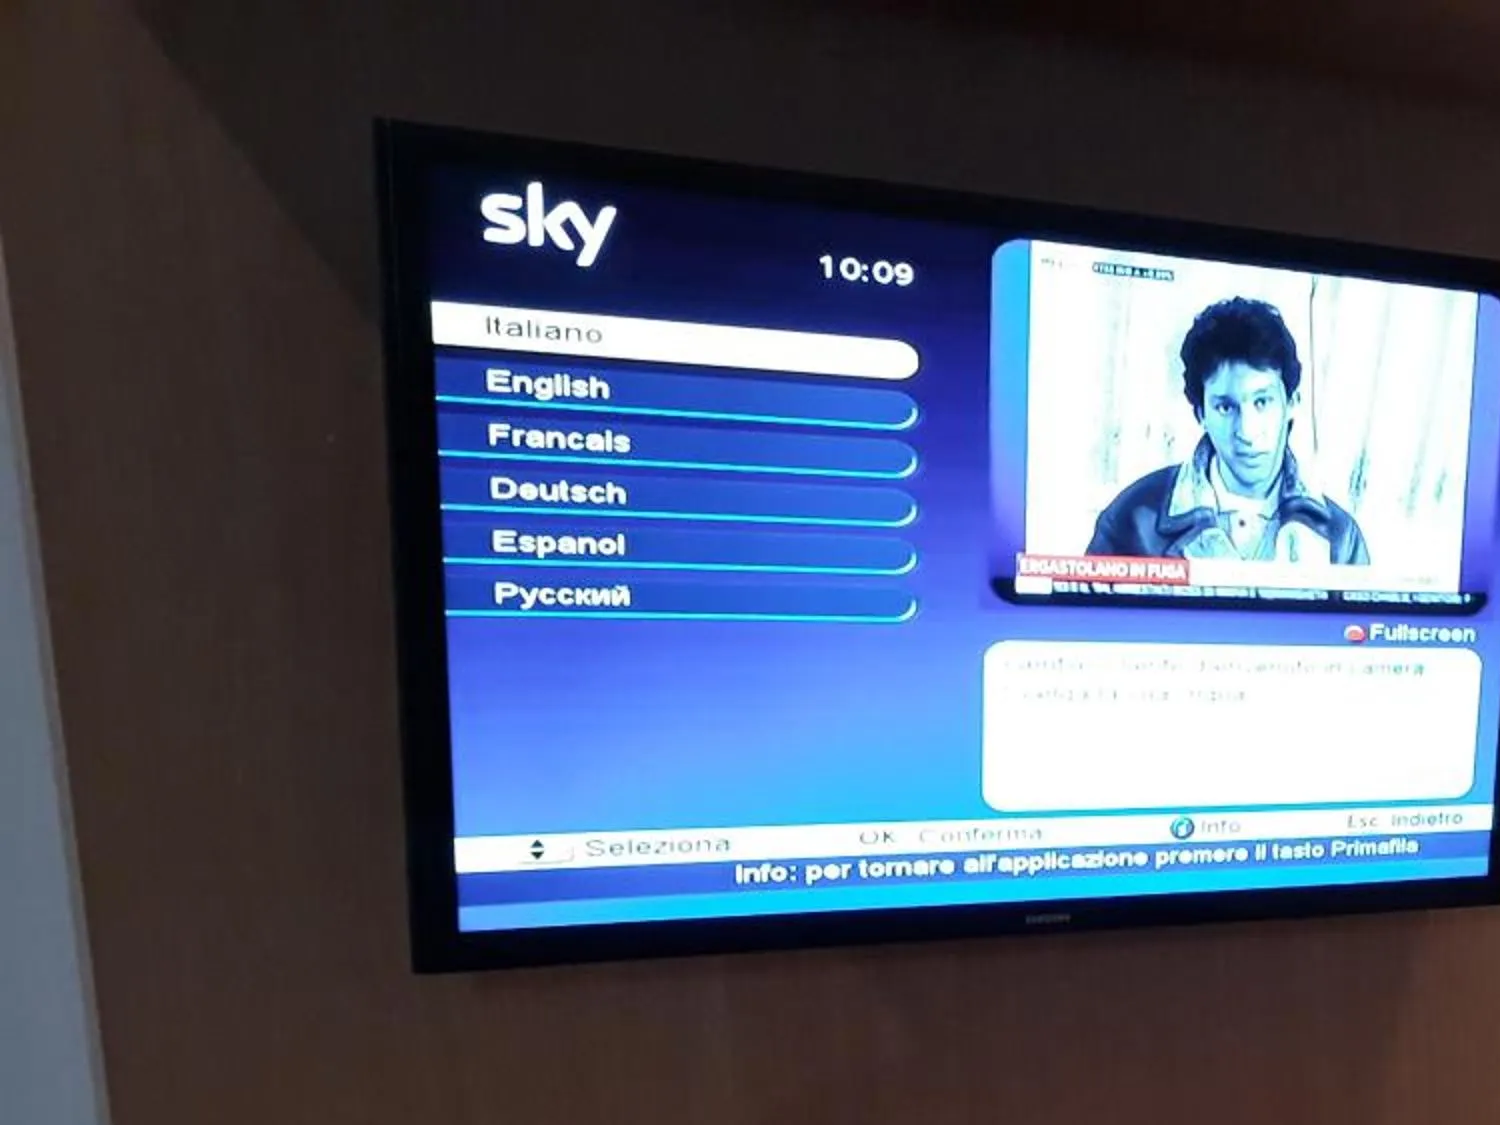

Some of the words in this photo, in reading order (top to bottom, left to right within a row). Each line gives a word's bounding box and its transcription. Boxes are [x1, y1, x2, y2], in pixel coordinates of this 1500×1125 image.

[480, 181, 617, 267] sky
[818, 254, 915, 286] 10:09
[485, 315, 603, 344] Italiano
[486, 367, 610, 400] English
[488, 423, 631, 453] Francais
[490, 476, 627, 504] Deutsch
[492, 529, 626, 558] Espanol
[1020, 557, 1129, 577] ERGASTOLANO
[1130, 563, 1148, 578] IN
[494, 582, 631, 610] Русский
[1369, 623, 1476, 643] Fullscreen
[1201, 819, 1242, 834] Info
[1391, 810, 1464, 827] Indietro
[585, 836, 731, 857] Seleziona
[919, 827, 1043, 844] Conferma
[735, 863, 797, 885] Info:
[805, 863, 852, 886] per
[858, 858, 955, 879] tornare
[963, 850, 1149, 877] all'applicazione
[1155, 846, 1249, 871] premere
[1255, 843, 1267, 862] il
[1272, 841, 1325, 860] tasto
